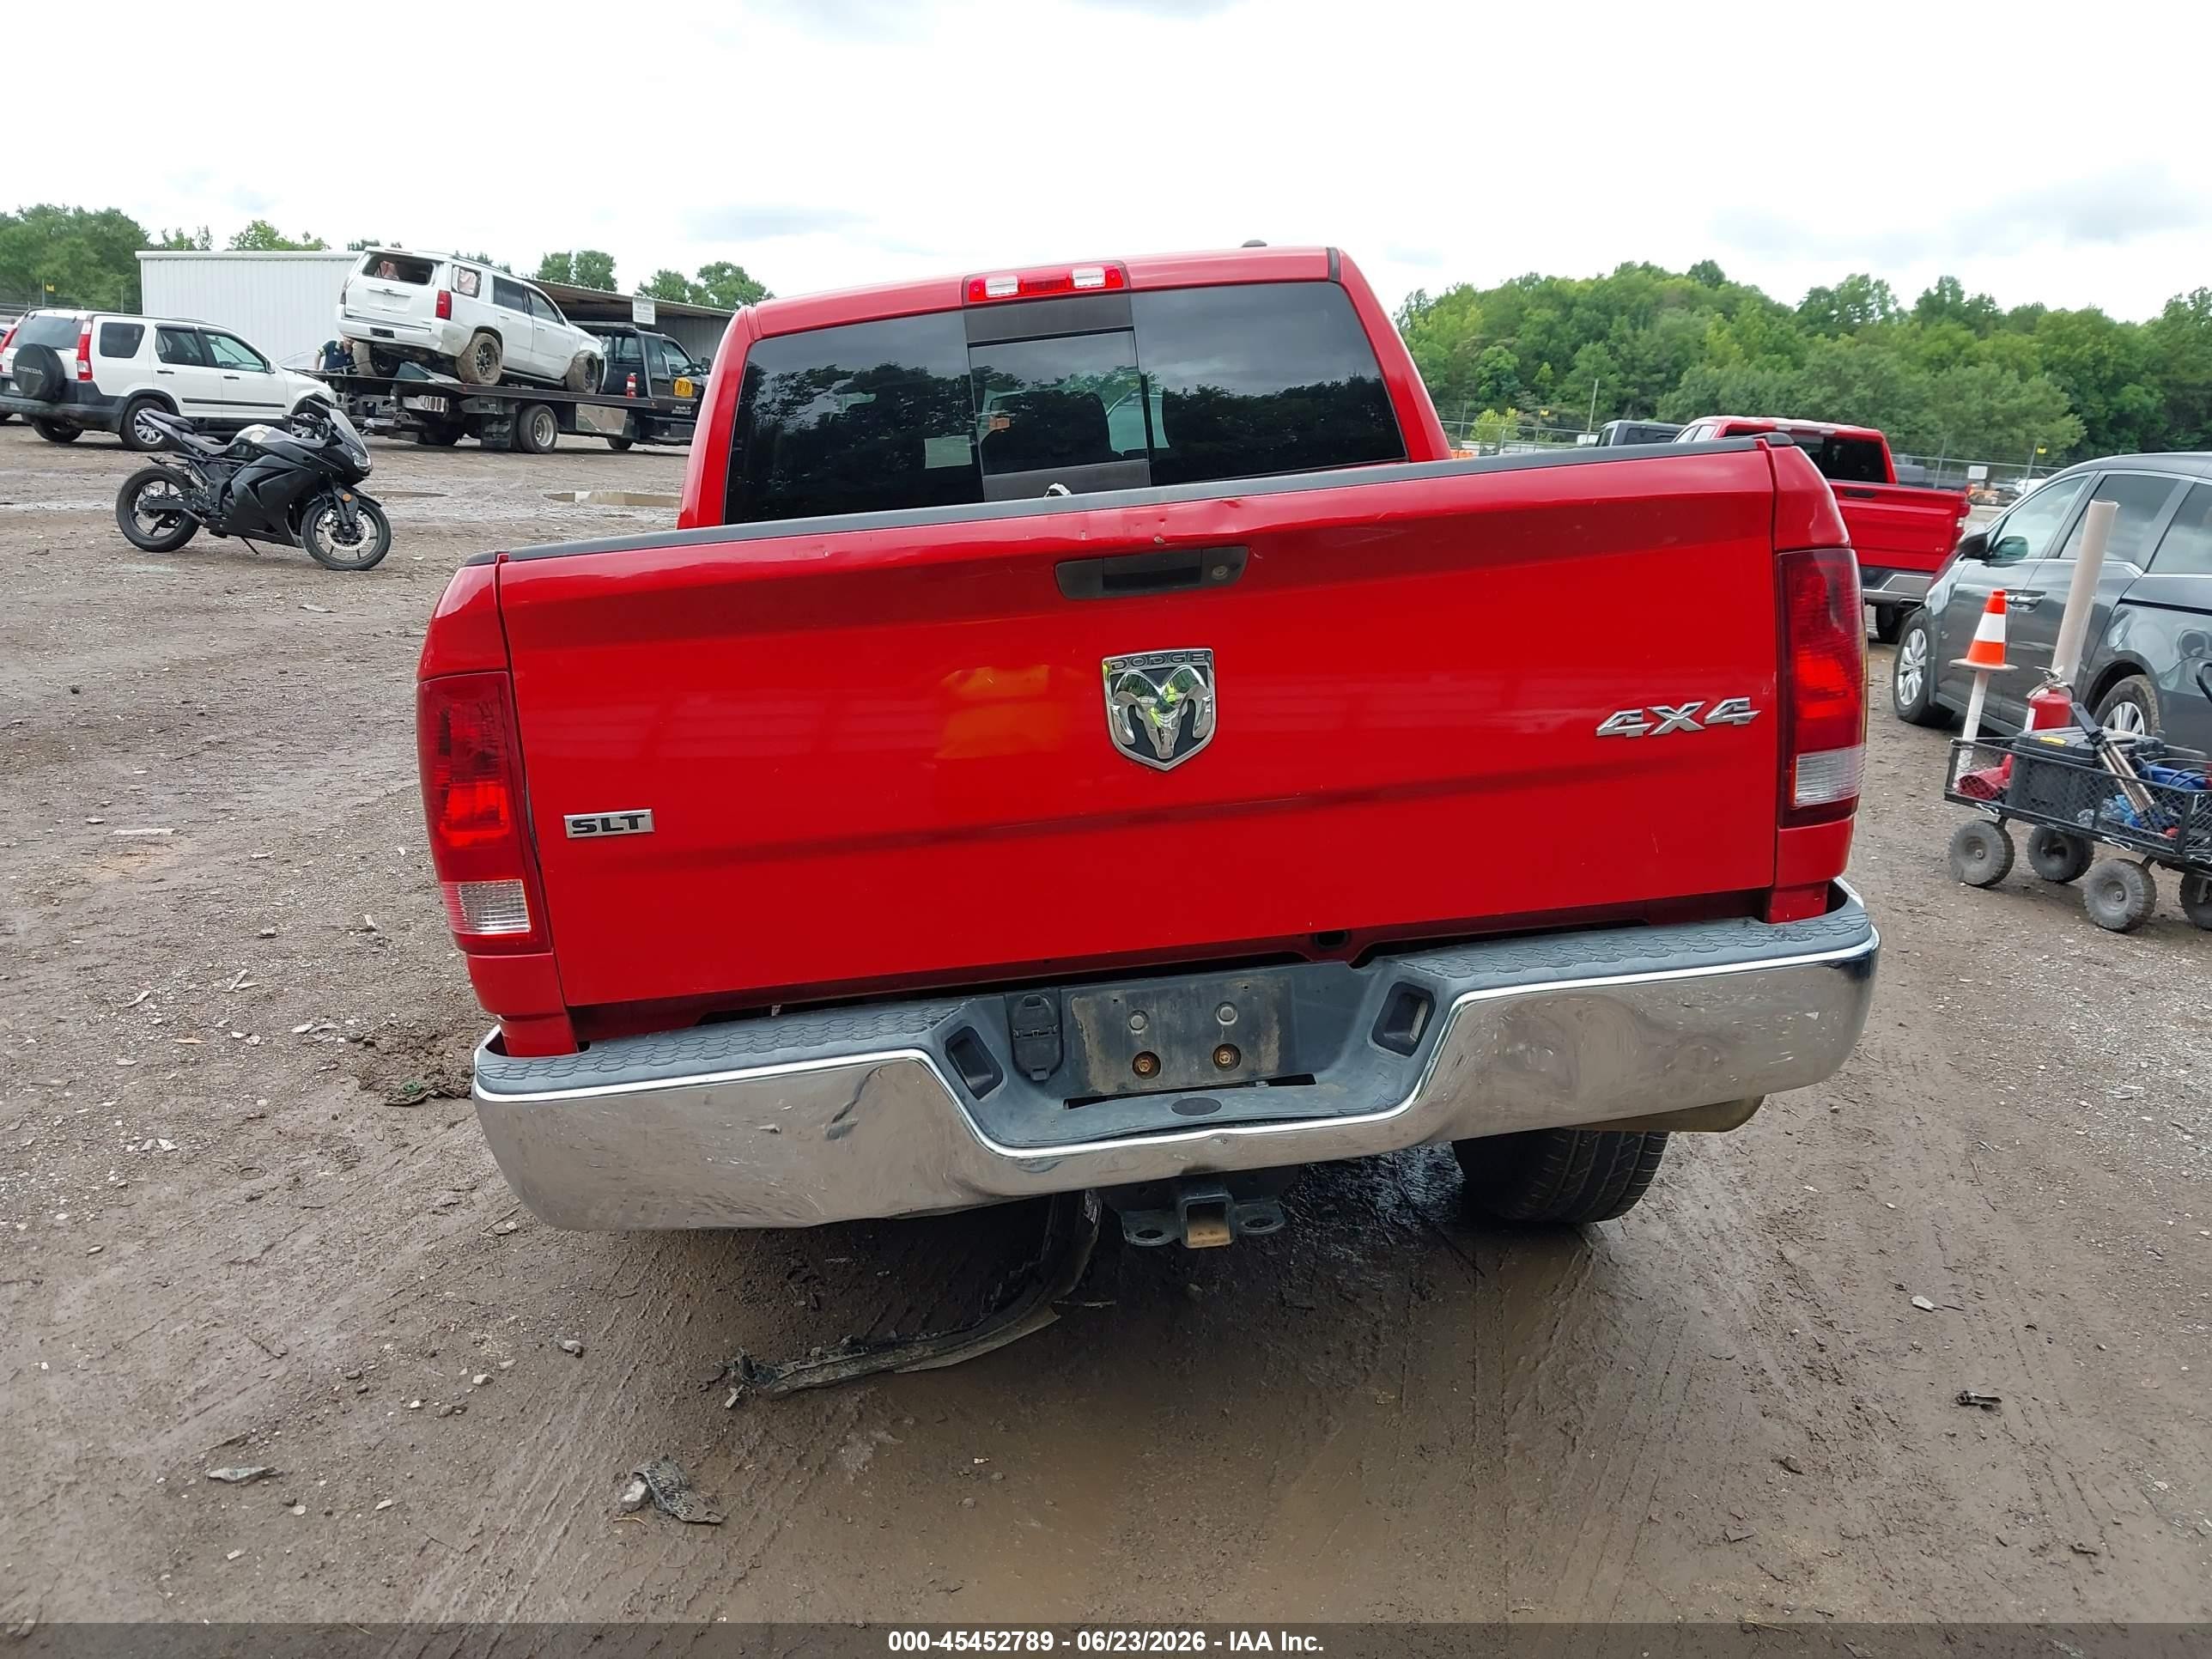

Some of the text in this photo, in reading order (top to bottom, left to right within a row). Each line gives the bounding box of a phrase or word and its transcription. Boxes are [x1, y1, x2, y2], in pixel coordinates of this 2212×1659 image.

[16, 365, 44, 375] HONDA
[1110, 652, 1206, 671] DODGE
[571, 814, 646, 835] SLT
